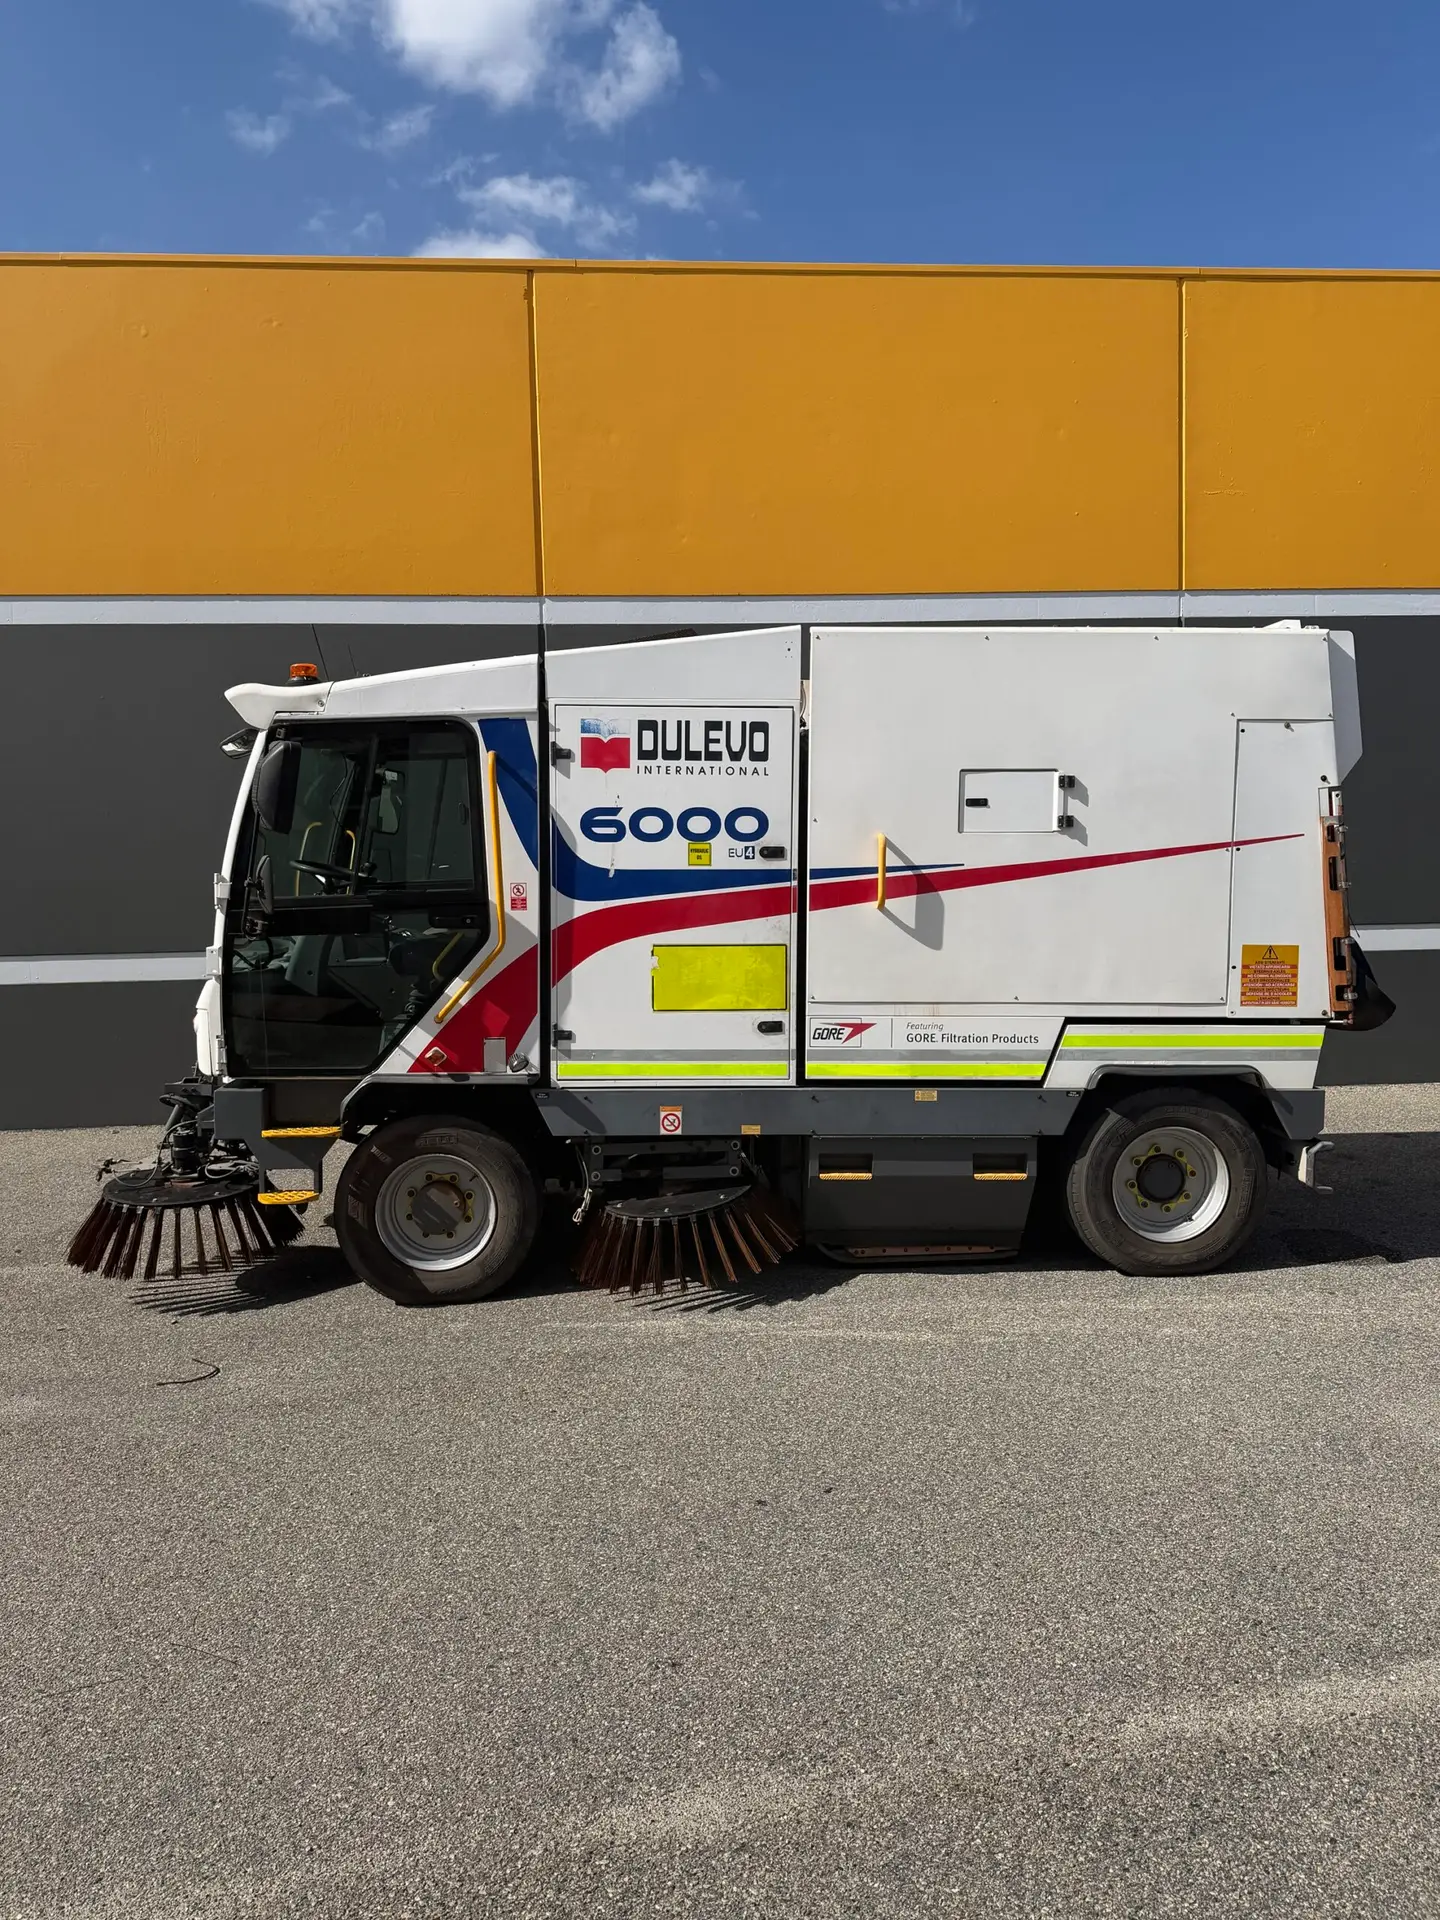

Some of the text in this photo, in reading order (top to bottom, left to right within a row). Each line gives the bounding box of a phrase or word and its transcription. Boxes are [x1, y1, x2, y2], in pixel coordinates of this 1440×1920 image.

[637, 720, 769, 761] DULEVO
[637, 765, 769, 776] INTERNATIONAL
[580, 806, 770, 843] 6000
[728, 847, 754, 858] EU4
[906, 1022, 944, 1032] Featuring
[812, 1028, 845, 1040] GORE
[941, 1033, 989, 1043] Filtration
[992, 1033, 1039, 1043] Products
